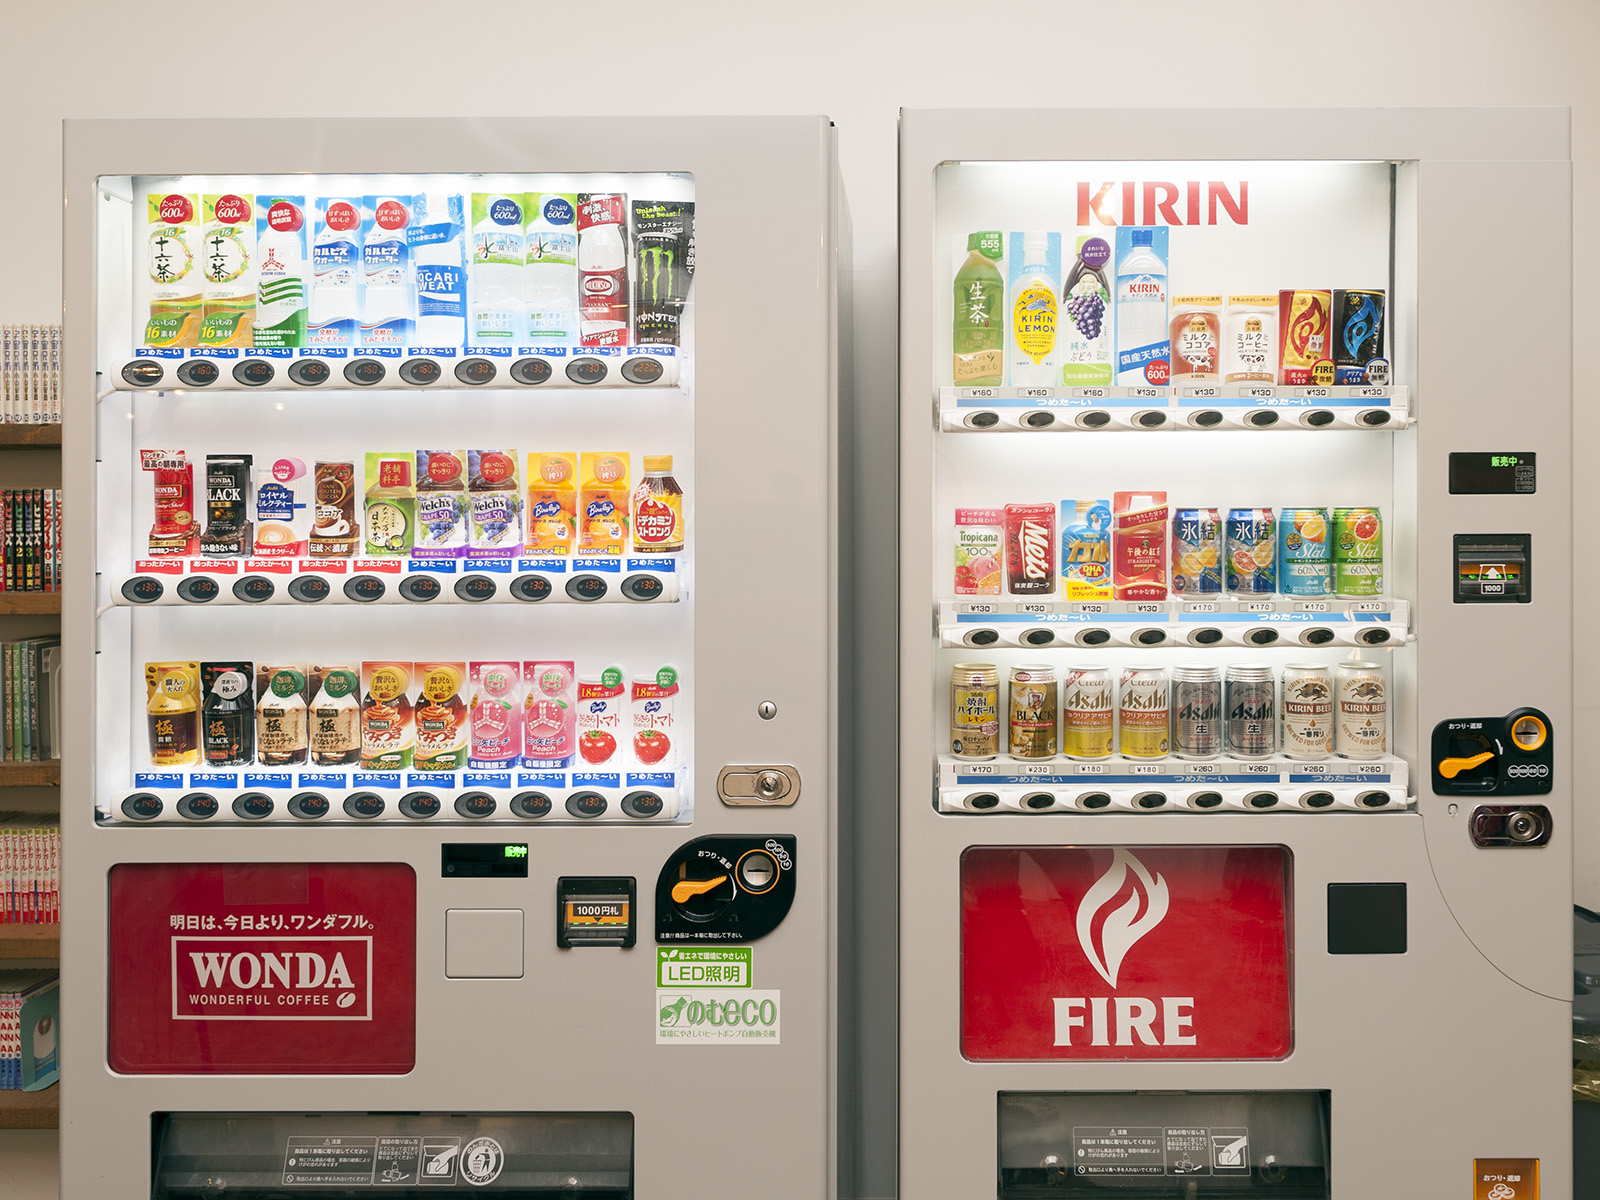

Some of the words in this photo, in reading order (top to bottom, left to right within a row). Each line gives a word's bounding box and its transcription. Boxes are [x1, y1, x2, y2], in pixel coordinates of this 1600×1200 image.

[1077, 181, 1248, 226] KIRIN
[271, 209, 290, 218] 爽快な
[981, 240, 999, 248] 555
[155, 237, 175, 282] 十六茶
[210, 237, 230, 282] 十六茶
[1130, 284, 1160, 293] KIRIN
[969, 281, 989, 324] 生茶
[1071, 342, 1088, 350] 純水
[1070, 351, 1091, 362] ぶどう
[1121, 346, 1170, 365] 国産天然水
[1083, 389, 1103, 397] ¥160
[1491, 456, 1518, 467] 販売中
[383, 464, 401, 473] 老舗
[383, 475, 400, 484] 料亭
[421, 498, 450, 511] Welch's
[474, 498, 504, 511] Welch's
[318, 510, 342, 518] ココア
[440, 511, 449, 519] 50
[371, 512, 381, 542] 日本茶
[637, 516, 671, 527] ドデカミン
[638, 527, 671, 538] ストロング
[960, 531, 998, 542] Tropicana
[1182, 522, 1215, 540] 氷結
[1236, 522, 1269, 540] 氷結
[1010, 533, 1019, 567] BLACK
[1024, 520, 1049, 579] Mets
[1296, 543, 1325, 558] Slat
[1348, 543, 1378, 557] Slat
[967, 698, 986, 706] 焼酎
[1068, 689, 1111, 709] Asahi
[1122, 688, 1166, 709] Asahi
[958, 706, 995, 715] ハイボール
[1016, 711, 1054, 720] BLACK
[1180, 702, 1219, 720] Asahi
[1231, 702, 1272, 720] Asahi
[155, 720, 174, 735] 極
[210, 721, 226, 736] 極
[266, 719, 282, 733] 極
[319, 719, 336, 732] 極
[1196, 724, 1207, 734] 生
[1248, 724, 1260, 734] 生
[1342, 724, 1359, 742] BREWED
[577, 906, 619, 915] 1000円札
[170, 915, 374, 930] 明日は、今日より、ワンダフル。
[189, 952, 355, 989] WONDA
[669, 966, 740, 982] LED照明
[189, 995, 270, 1005] WONDERFUL
[278, 995, 329, 1005] COFFEE
[1052, 997, 1197, 1046] FIRE
[467, 1139, 499, 1155] のんだあとは
[466, 1171, 496, 1183] リサイクル
